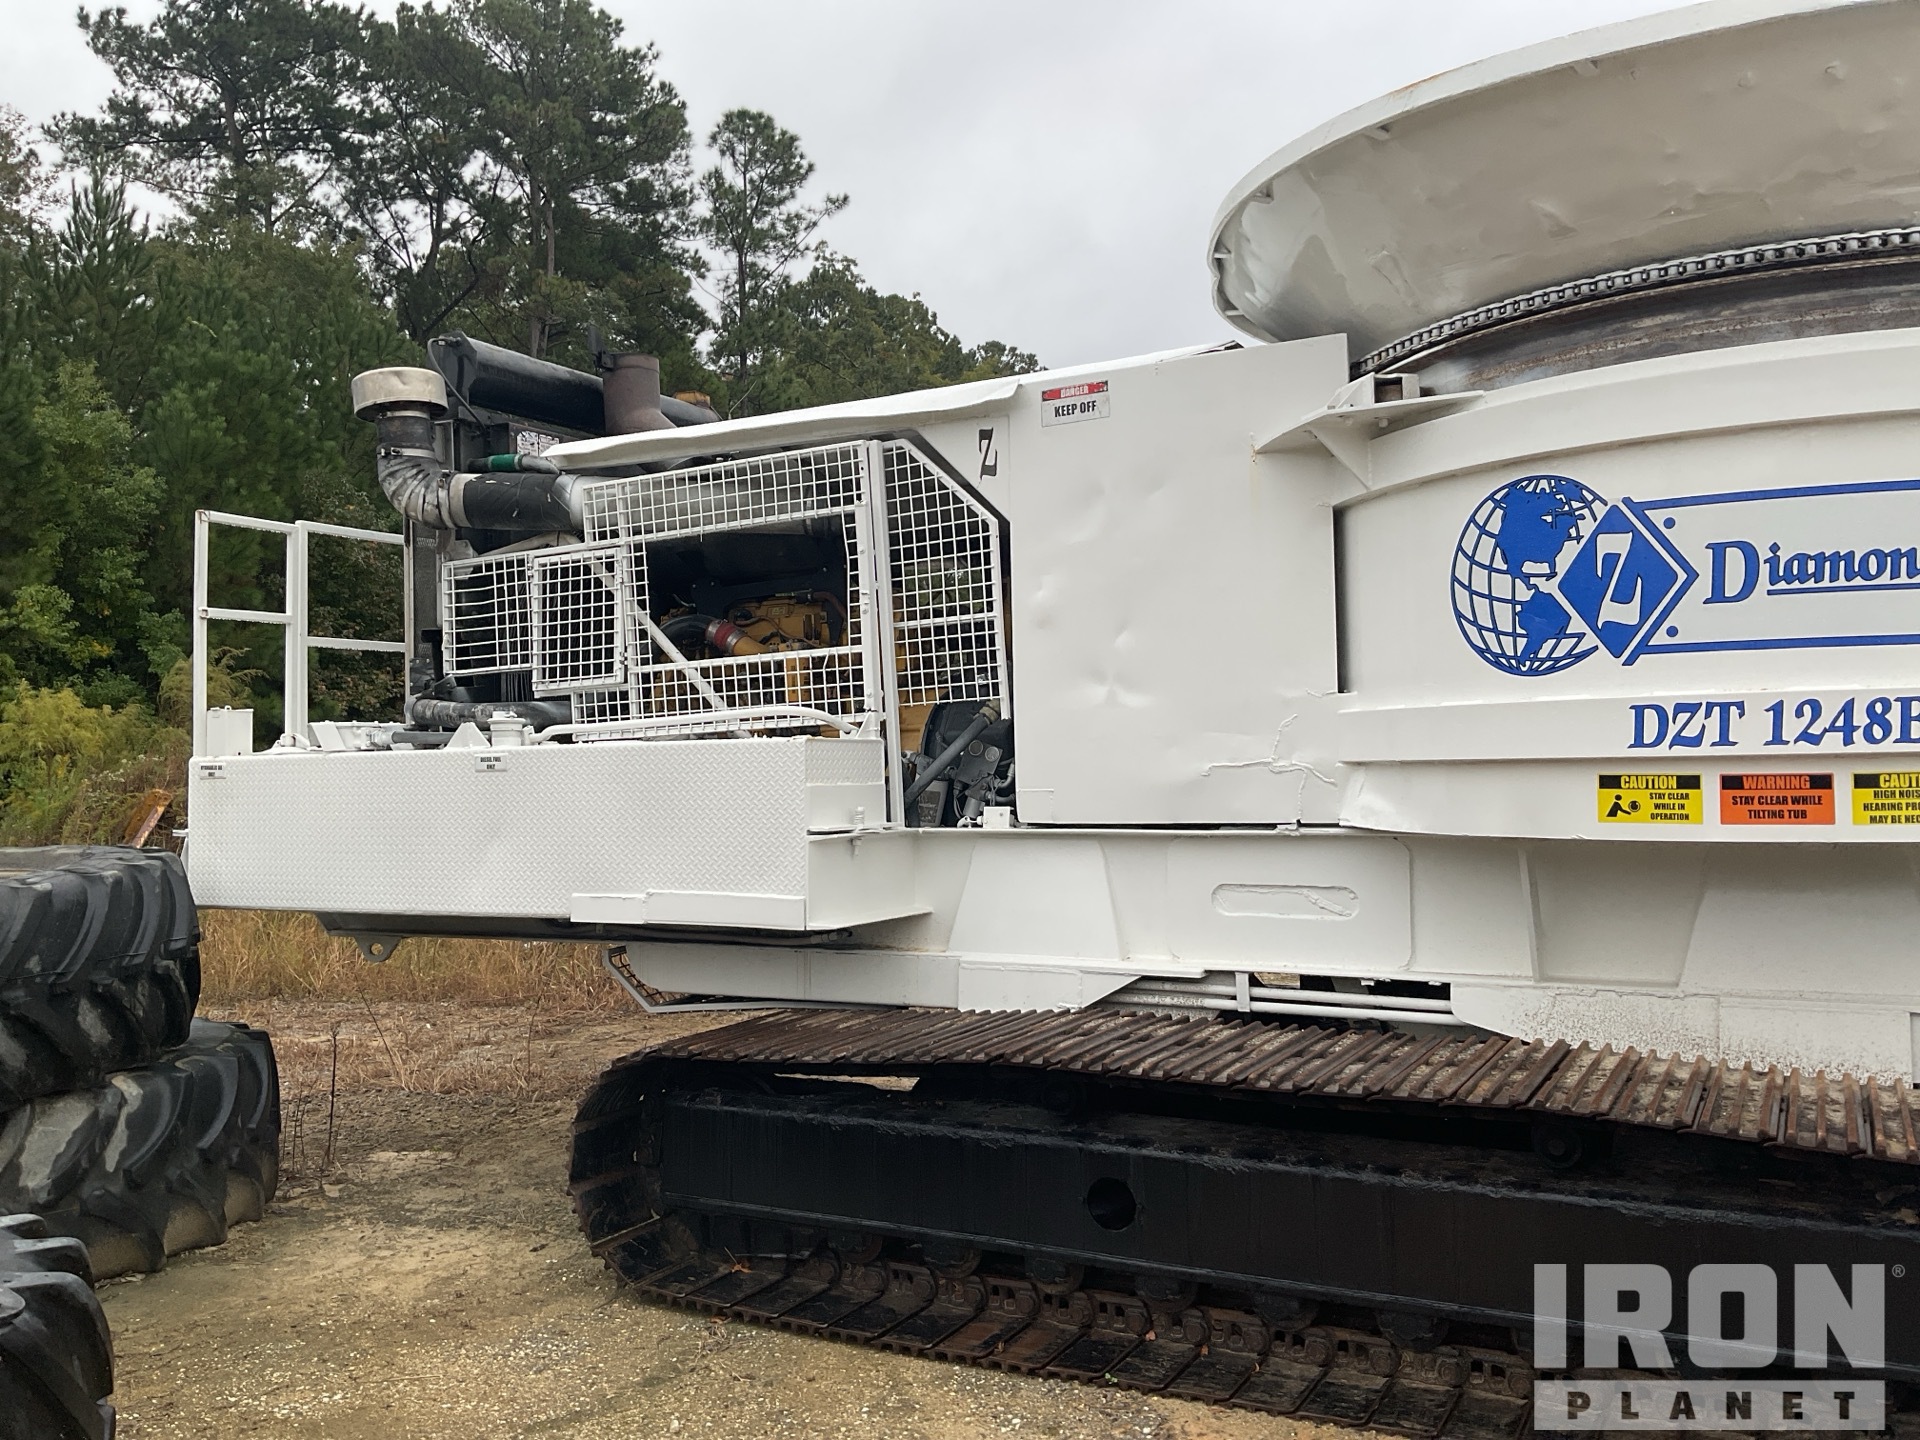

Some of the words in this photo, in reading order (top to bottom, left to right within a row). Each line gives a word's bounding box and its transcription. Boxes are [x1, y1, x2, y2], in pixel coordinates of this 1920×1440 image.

[1060, 385, 1089, 398] DANGER
[1054, 403, 1078, 418] KEEP
[1080, 400, 1097, 414] OFF
[1703, 540, 1920, 605] Diamon
[1595, 530, 1643, 632] Z
[1627, 700, 1746, 750] DZT
[1621, 775, 1677, 789] CAUTION
[1742, 775, 1811, 789] WARNING
[1879, 773, 1920, 788] CAUT
[1649, 792, 1666, 800] STAY
[1667, 792, 1690, 800] CLEAR
[1731, 796, 1755, 806] STAY
[1757, 796, 1789, 806] CLEAR
[1790, 795, 1823, 806] WHILE
[1873, 789, 1897, 799] HIGH
[1863, 802, 1903, 812] HEARING
[1650, 813, 1690, 821] OPERATION
[1747, 809, 1785, 820] TILTING
[1787, 809, 1808, 820] TUB
[1869, 814, 1889, 824] MAY
[1890, 814, 1903, 824] BE
